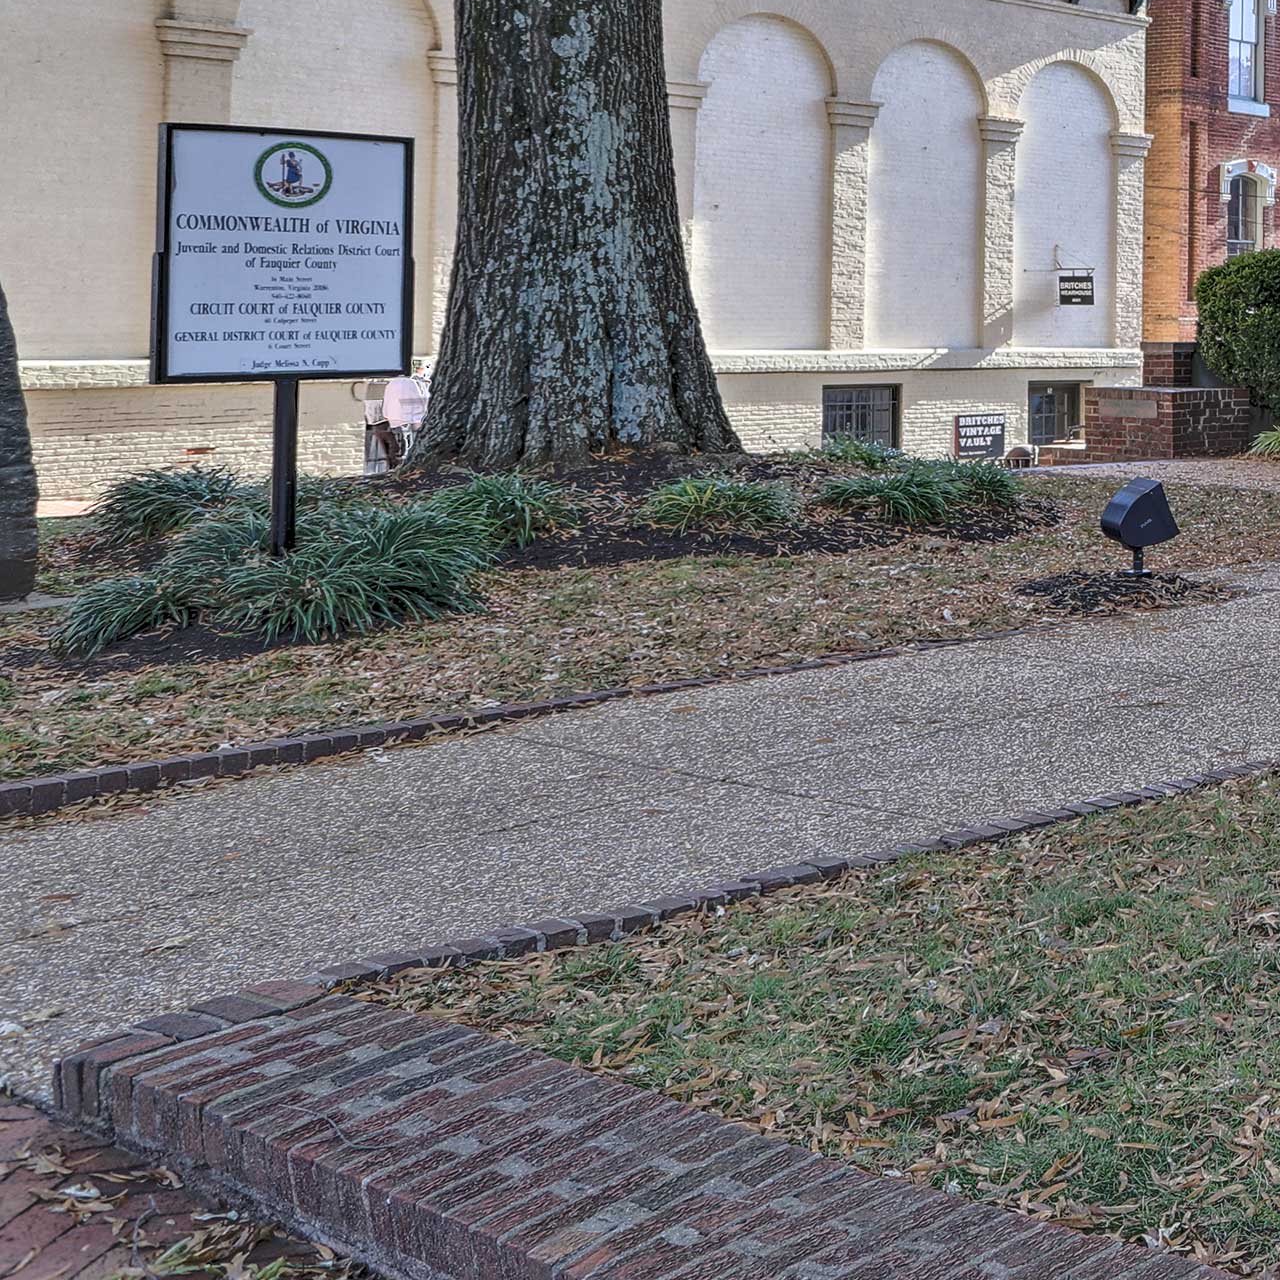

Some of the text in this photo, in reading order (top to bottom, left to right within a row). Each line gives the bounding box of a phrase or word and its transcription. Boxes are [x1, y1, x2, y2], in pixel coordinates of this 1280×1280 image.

[176, 213, 400, 236] COMMONWEALTH of VIRGINIA
[175, 241, 401, 257] Juvenile and Domestic Relations District Court
[245, 257, 337, 272] of Fauquier County
[1060, 281, 1092, 290] BRITCHES
[190, 302, 387, 317] CIRCUIT COURT of FAUQUIER COUNTY
[174, 329, 396, 342] GENERAL DISTRICT COURT of FAUQUIER COUNTY
[251, 360, 272, 369] Judge
[959, 416, 1005, 426] BRITCHES
[959, 426, 1002, 436] VINTAGE
[959, 436, 993, 447] VAULT
